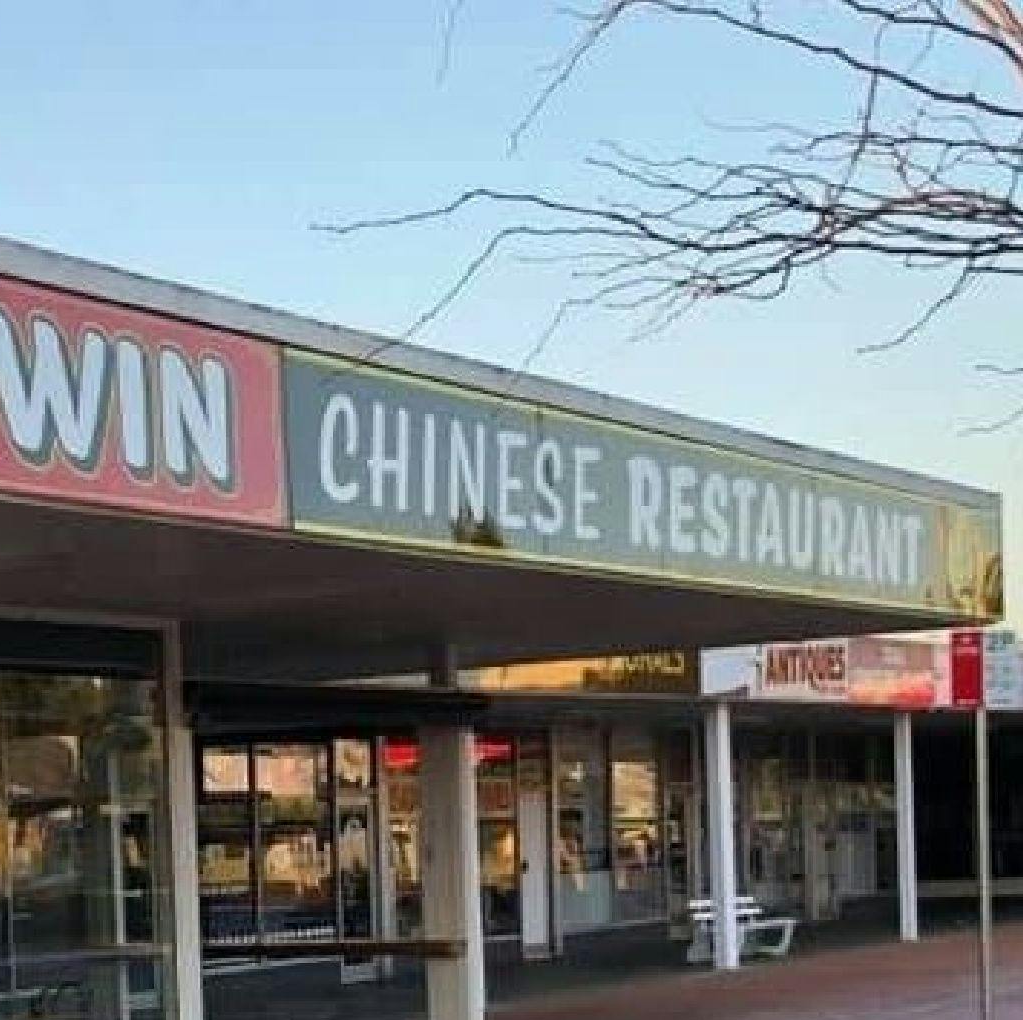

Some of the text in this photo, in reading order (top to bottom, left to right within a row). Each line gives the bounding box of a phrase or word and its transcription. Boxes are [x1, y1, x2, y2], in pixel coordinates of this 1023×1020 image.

[319, 393, 923, 586] CHINESE RESTAURANT
[765, 643, 846, 690] ANTIQUES
